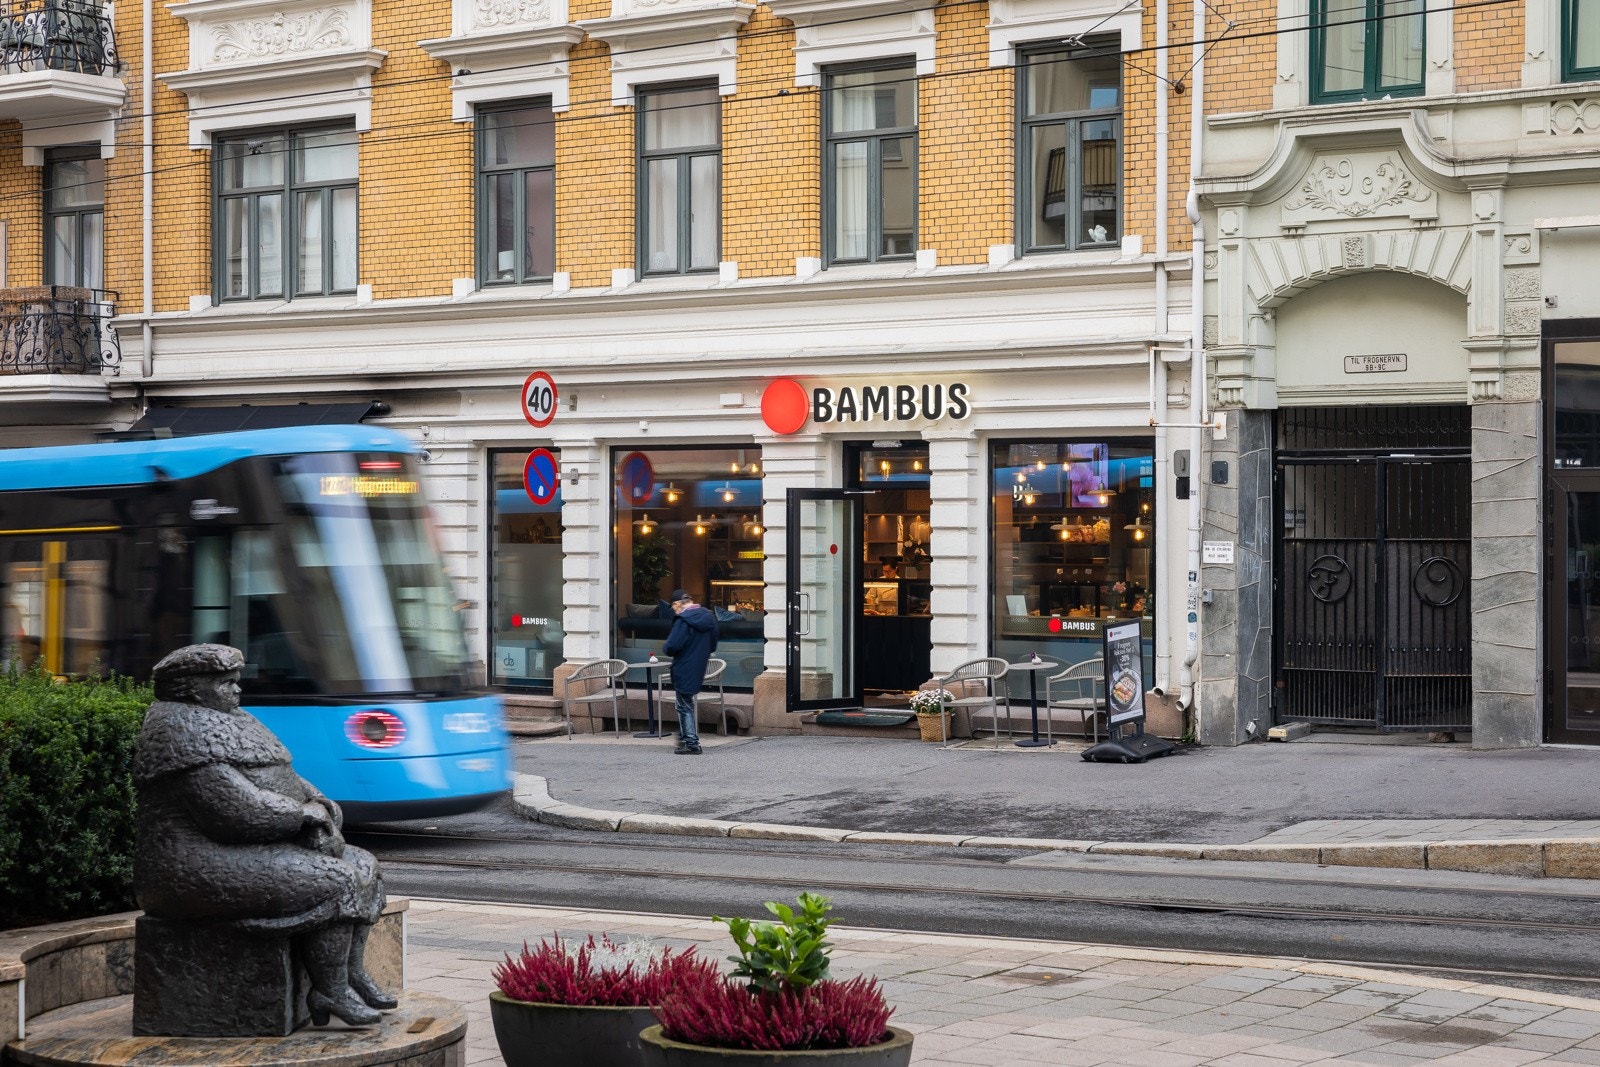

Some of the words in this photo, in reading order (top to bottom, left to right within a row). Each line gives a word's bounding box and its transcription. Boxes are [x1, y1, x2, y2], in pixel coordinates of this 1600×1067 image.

[527, 386, 552, 414] 40
[813, 383, 969, 423] BAMBUS
[522, 617, 548, 625] BAMBUS
[1062, 621, 1096, 631] BAMBUS
